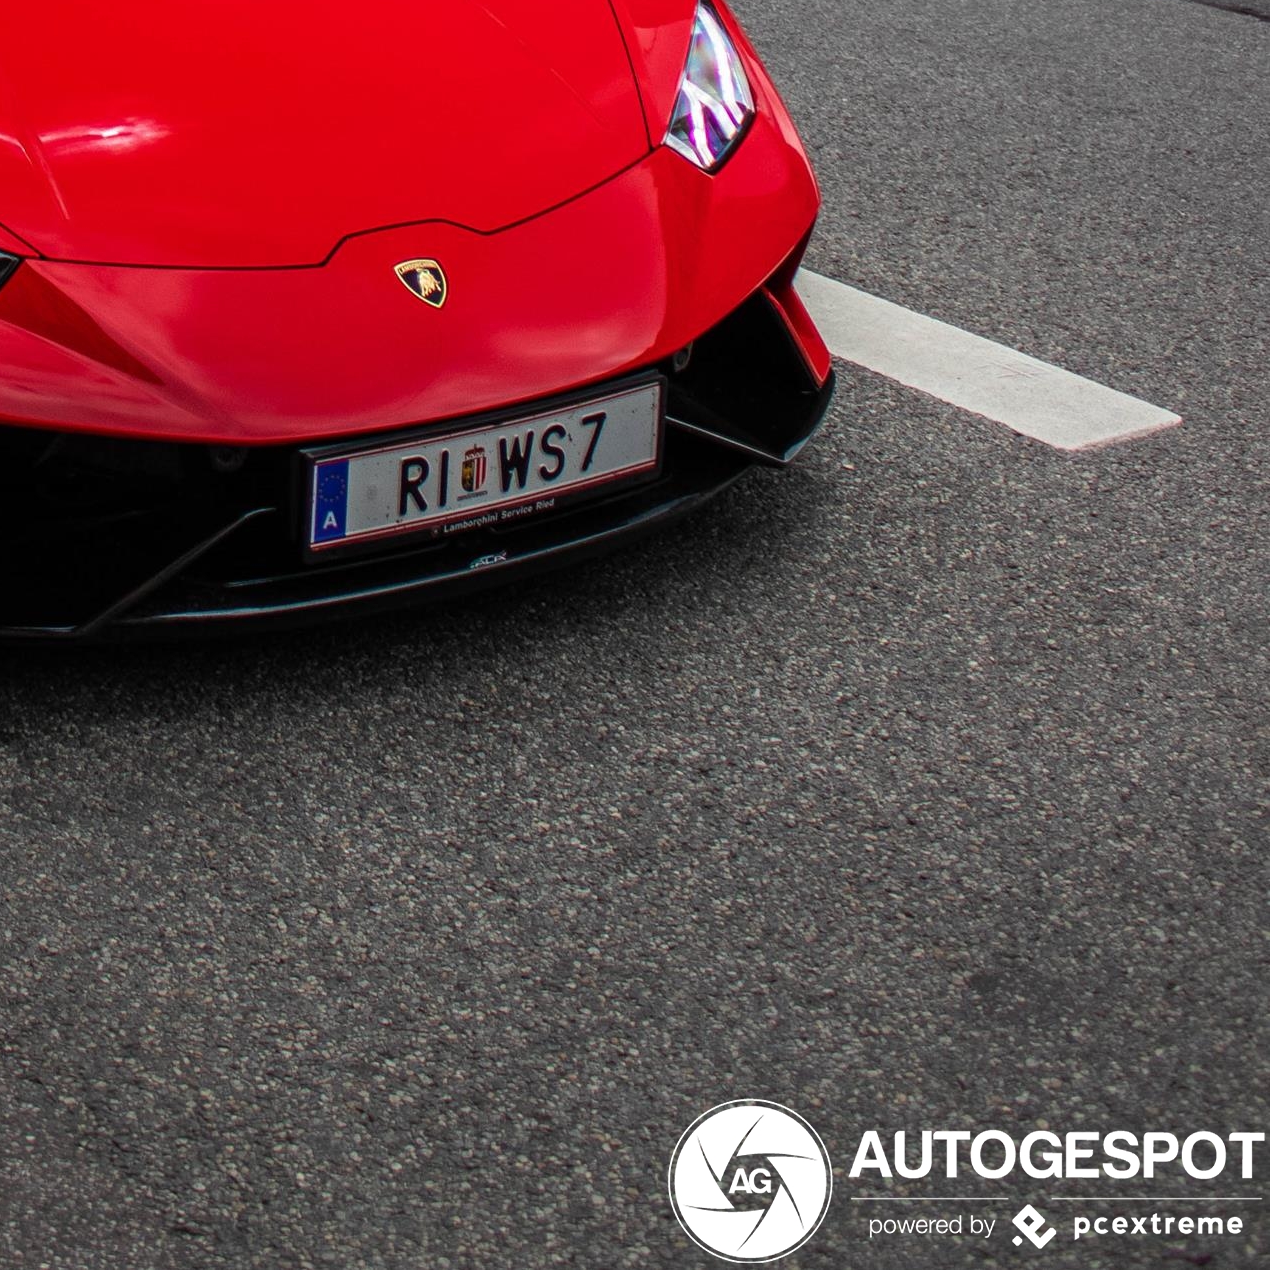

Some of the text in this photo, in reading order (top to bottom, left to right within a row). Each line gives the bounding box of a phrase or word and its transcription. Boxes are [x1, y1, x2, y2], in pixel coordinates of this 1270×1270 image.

[322, 510, 338, 530] A
[443, 498, 555, 533] Lamborghini Service Ried
